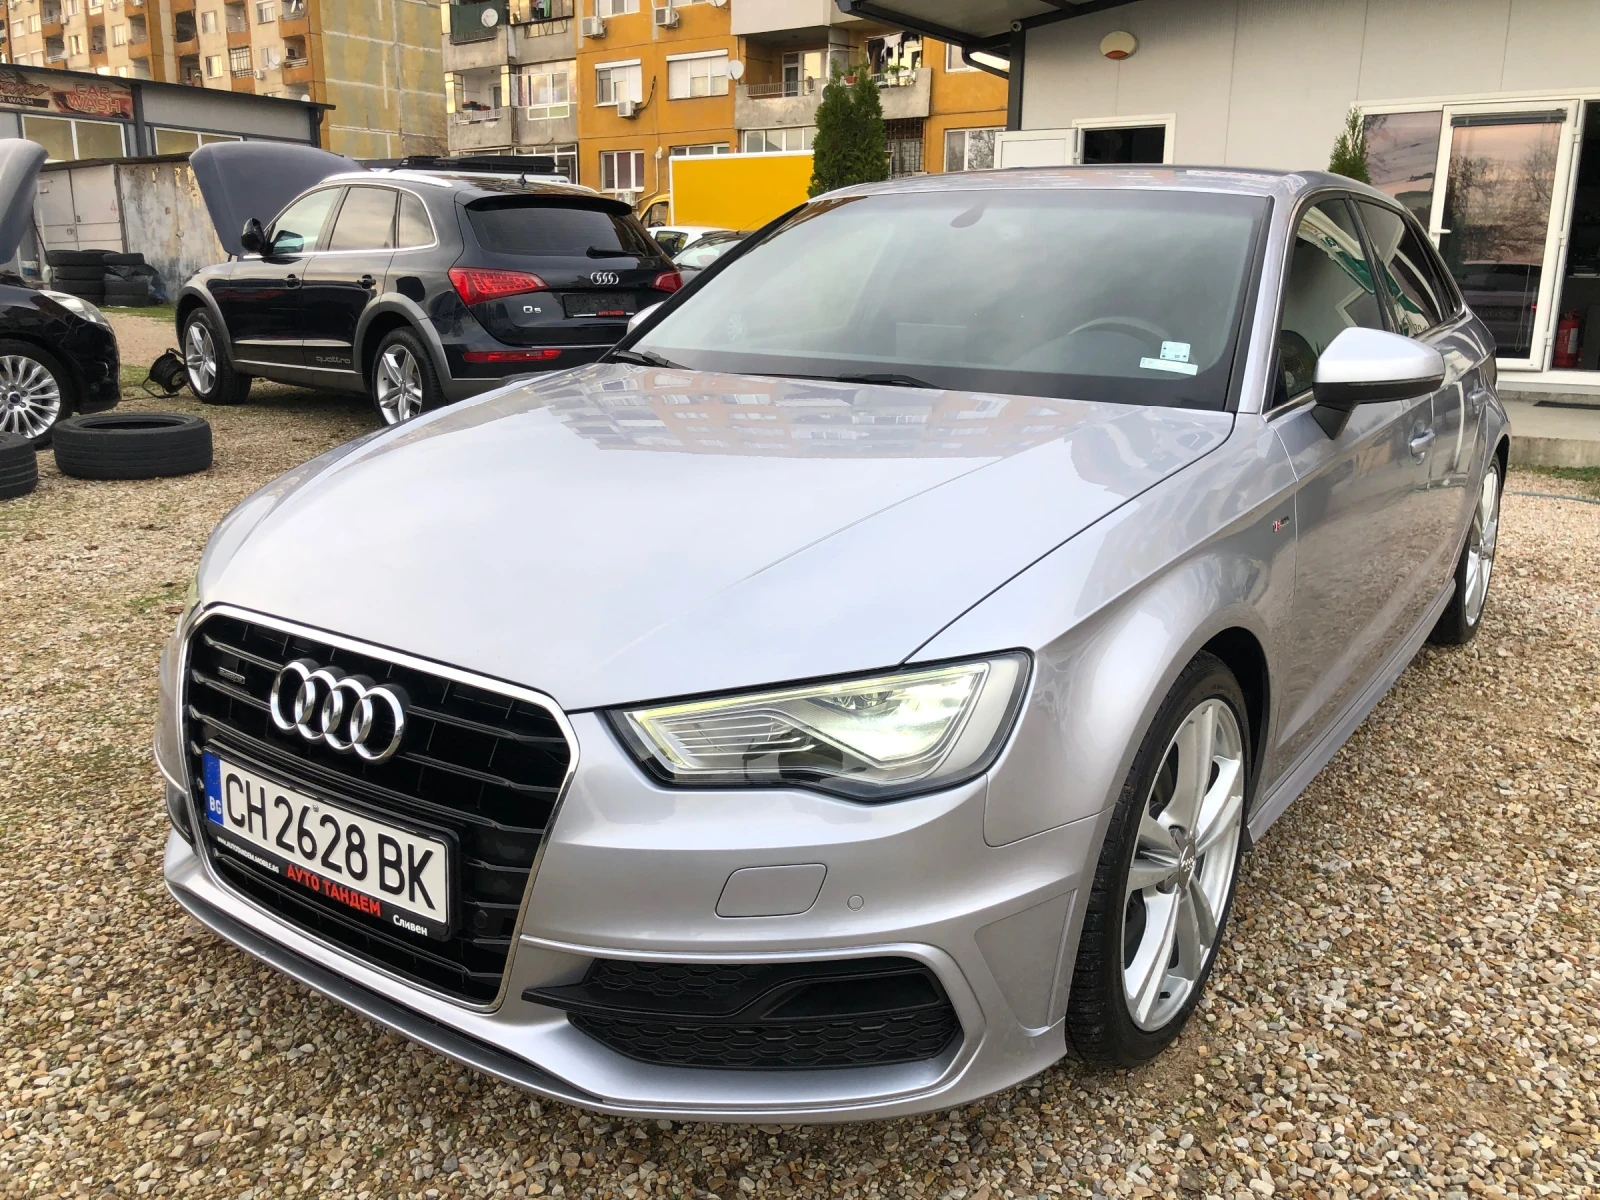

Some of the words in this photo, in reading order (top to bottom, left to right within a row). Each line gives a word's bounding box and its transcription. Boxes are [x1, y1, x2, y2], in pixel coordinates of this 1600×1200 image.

[74, 83, 110, 98] CAR
[66, 94, 121, 113] WASH
[523, 305, 541, 314] Q5
[316, 356, 351, 364] quattro
[209, 796, 222, 815] BG
[287, 864, 320, 891] АУТО
[322, 880, 381, 917] ТАНДЕМ
[393, 914, 428, 936] Сливен
